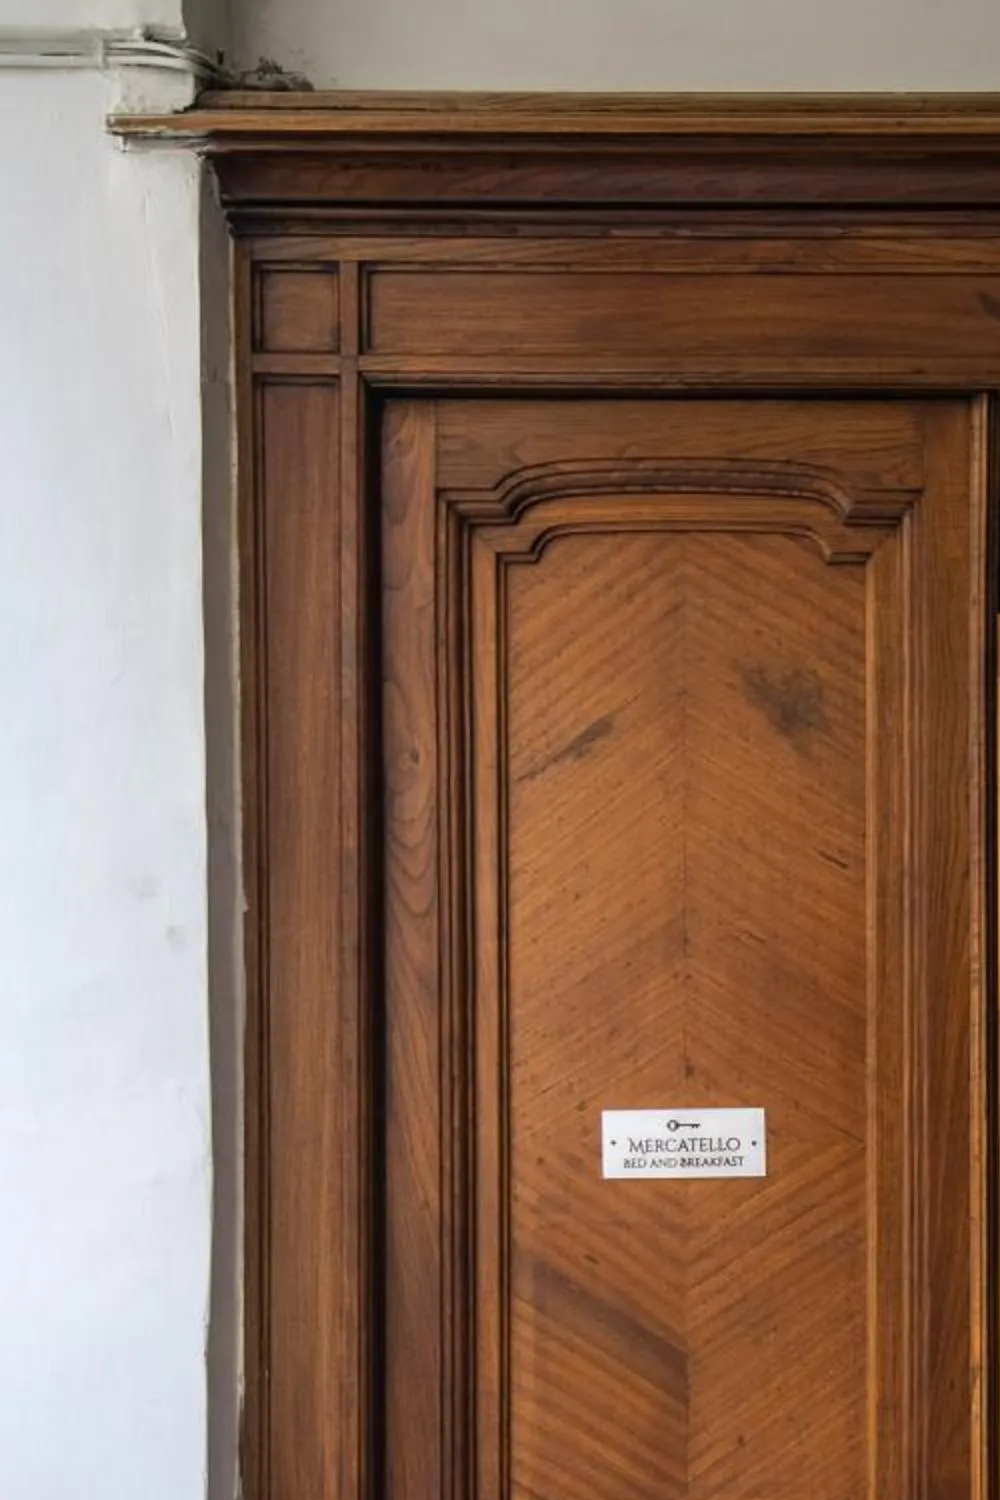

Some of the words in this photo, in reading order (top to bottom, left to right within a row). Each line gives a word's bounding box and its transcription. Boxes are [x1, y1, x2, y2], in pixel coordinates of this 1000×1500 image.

[629, 1137, 741, 1154] MERCATELLO
[623, 1157, 647, 1169] BED
[649, 1157, 678, 1168] AND
[679, 1156, 744, 1168] BREAKFAST
